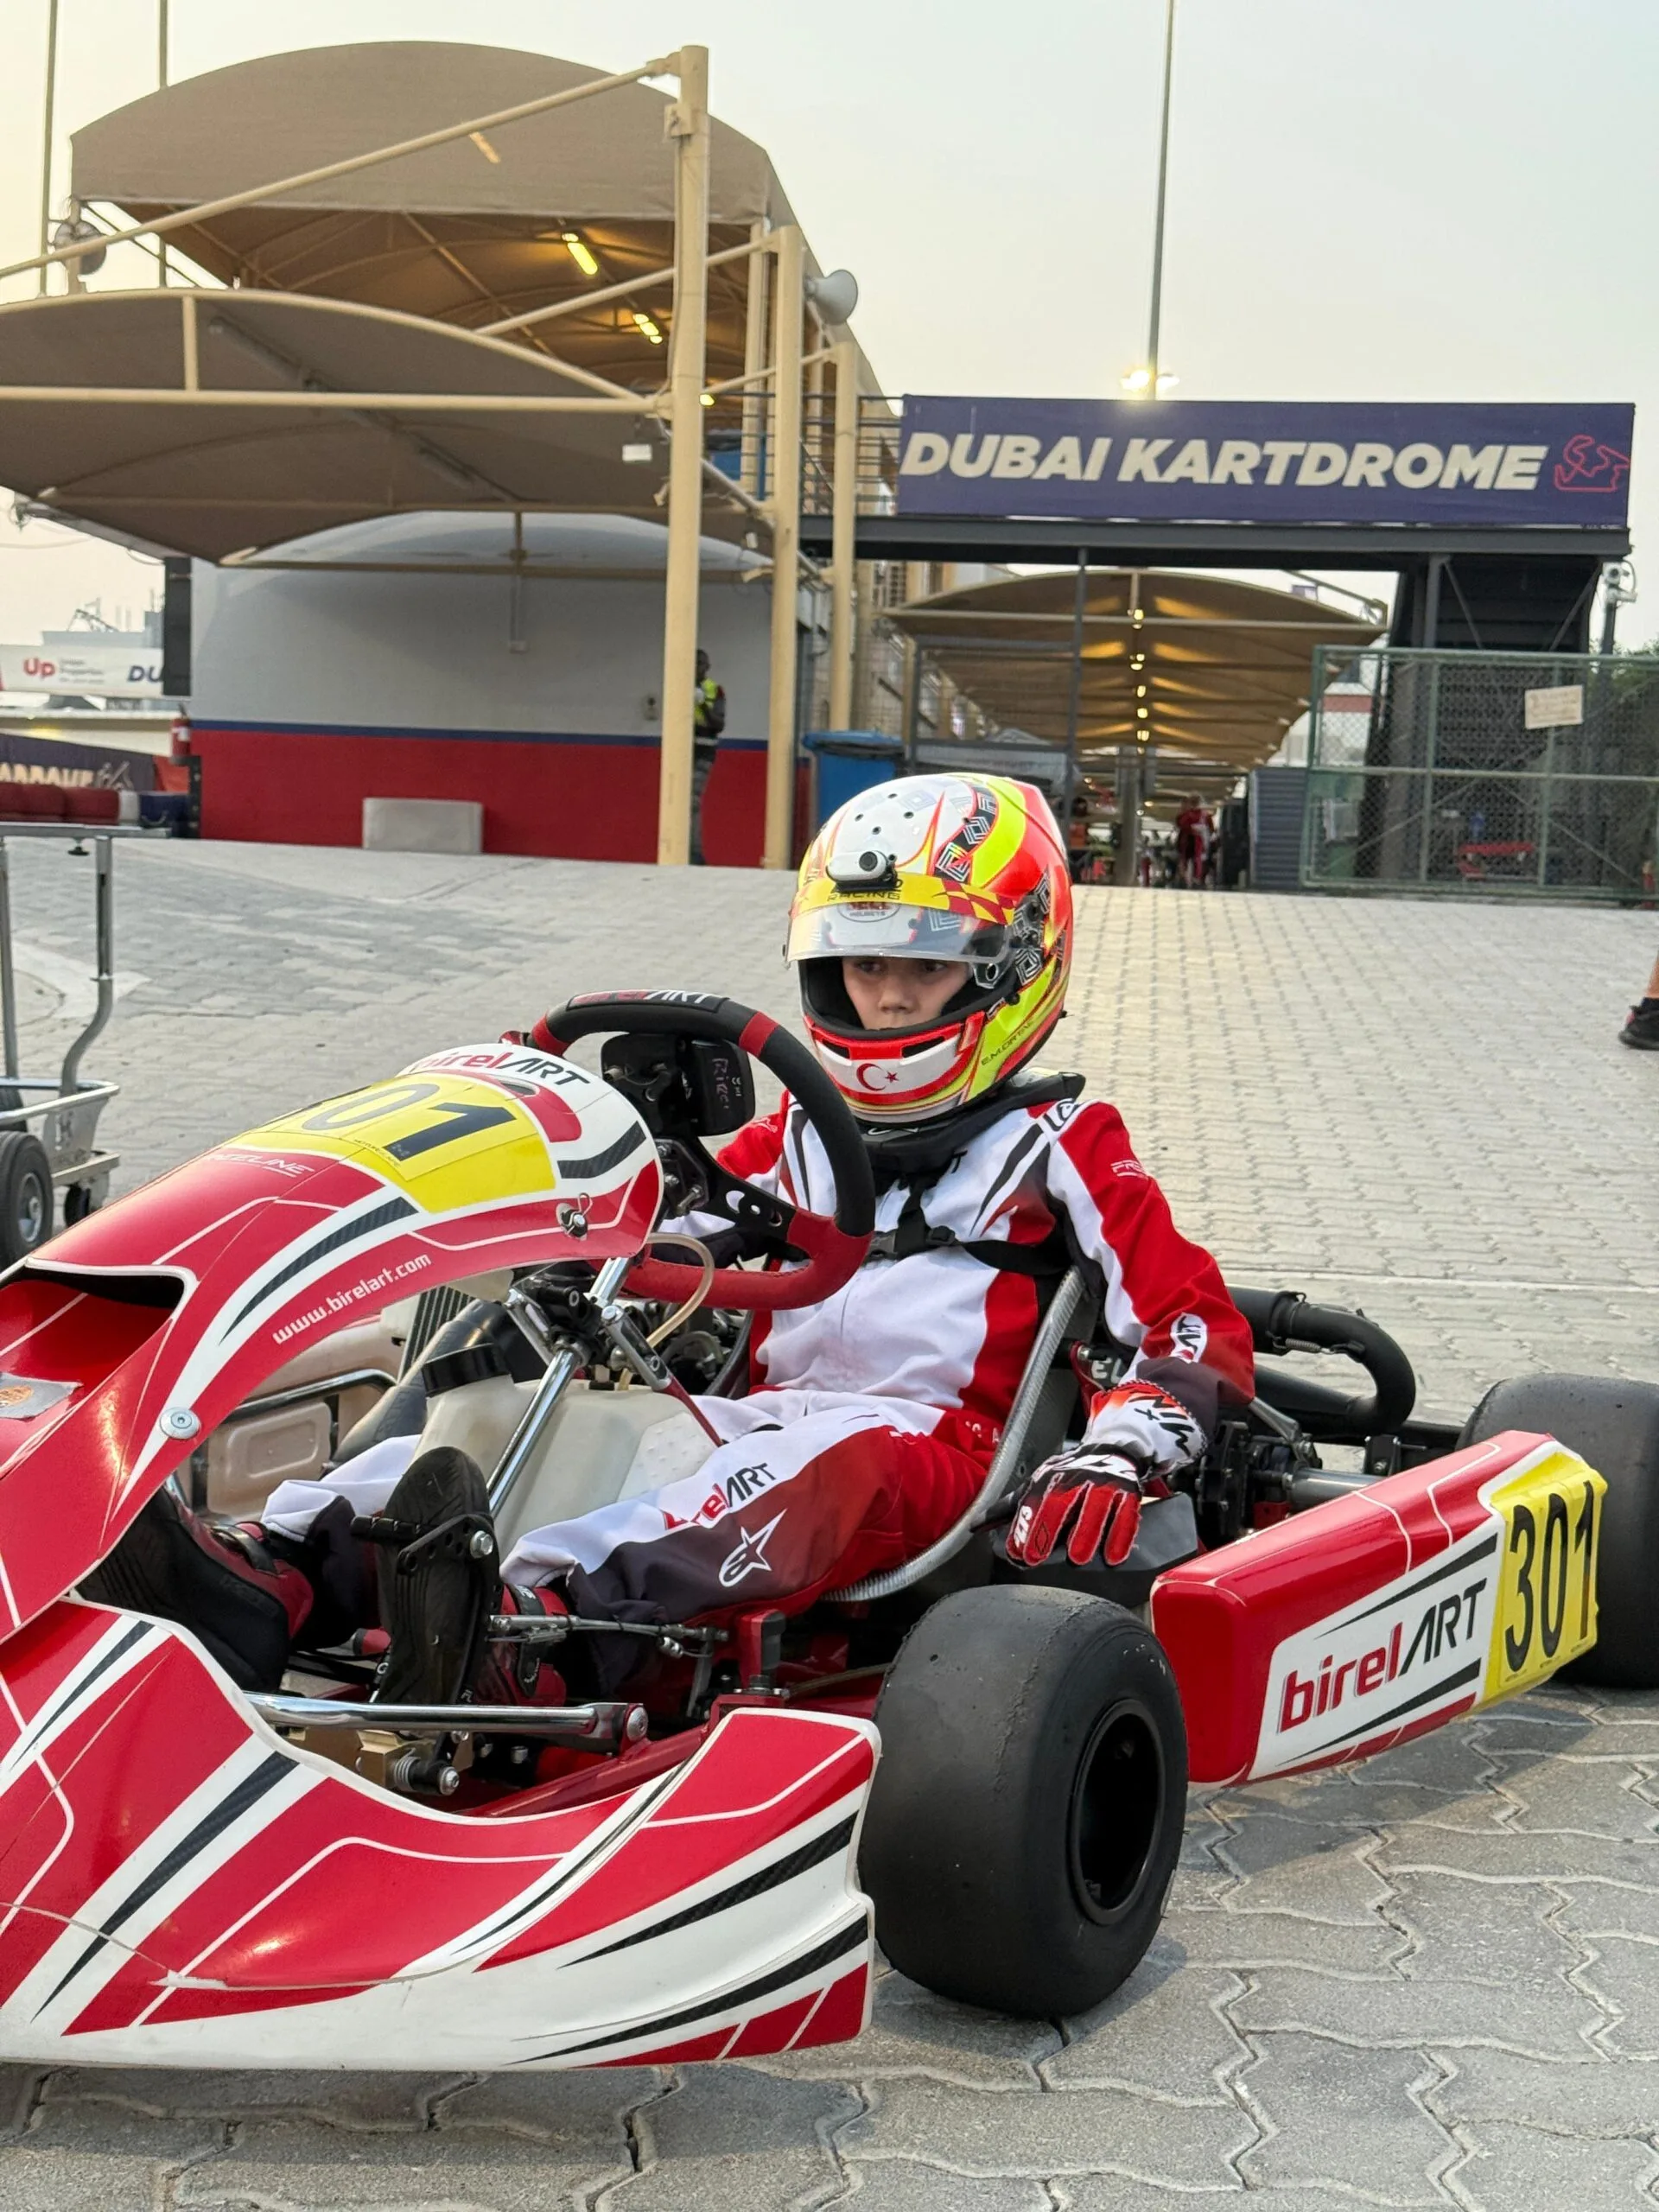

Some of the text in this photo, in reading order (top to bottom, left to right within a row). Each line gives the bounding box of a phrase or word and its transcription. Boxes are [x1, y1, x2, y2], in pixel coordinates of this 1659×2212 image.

[900, 432, 1549, 491] DUBAI KARTDROME
[23, 658, 56, 679] Up
[827, 891, 900, 902] RACING
[272, 1254, 433, 1345] www.birelart.com
[1505, 1479, 1596, 1673] 301
[1278, 1578, 1487, 1733] birelART
